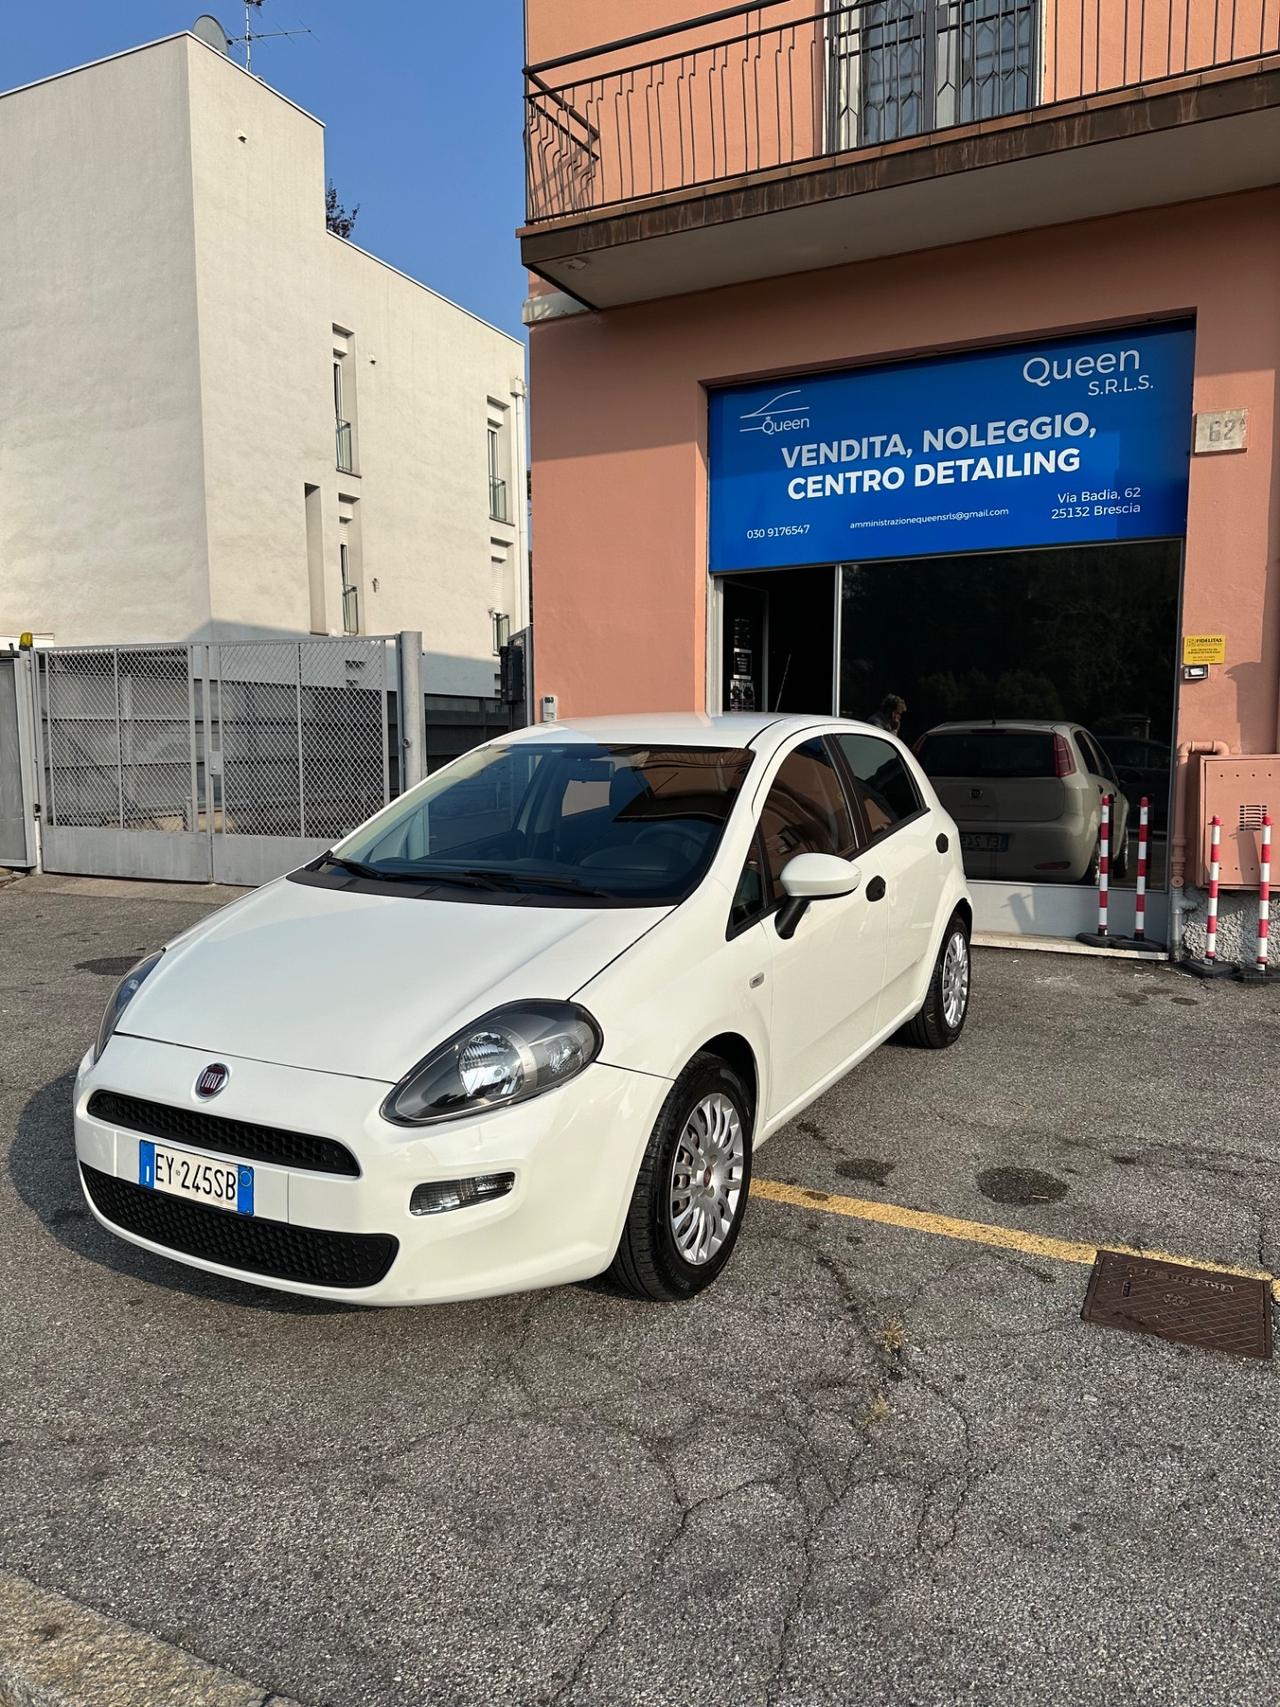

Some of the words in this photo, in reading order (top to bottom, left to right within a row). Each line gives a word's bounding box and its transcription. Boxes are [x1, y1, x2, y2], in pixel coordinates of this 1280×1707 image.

[1023, 349, 1140, 387] Queen
[1088, 375, 1154, 396] S.R.L.S.
[762, 417, 810, 435] Queen
[781, 433, 913, 469] VENDITA,
[922, 411, 1097, 453] NOLEGGIO,
[787, 466, 905, 500] CENTRO
[914, 448, 1080, 487] DETAILING
[1057, 493, 1077, 504] Via
[1081, 488, 1121, 503] Badia,
[1124, 487, 1142, 499] 62
[849, 508, 1009, 529] amministrazionequeensrls@gmail.com
[1051, 508, 1090, 520] 25132
[1094, 503, 1141, 516] Brescia
[747, 528, 766, 540] 030
[767, 524, 811, 538] 9176547
[201, 1072, 224, 1090] FIAT
[155, 1153, 175, 1185] EY
[180, 1160, 237, 1201] 245SB
